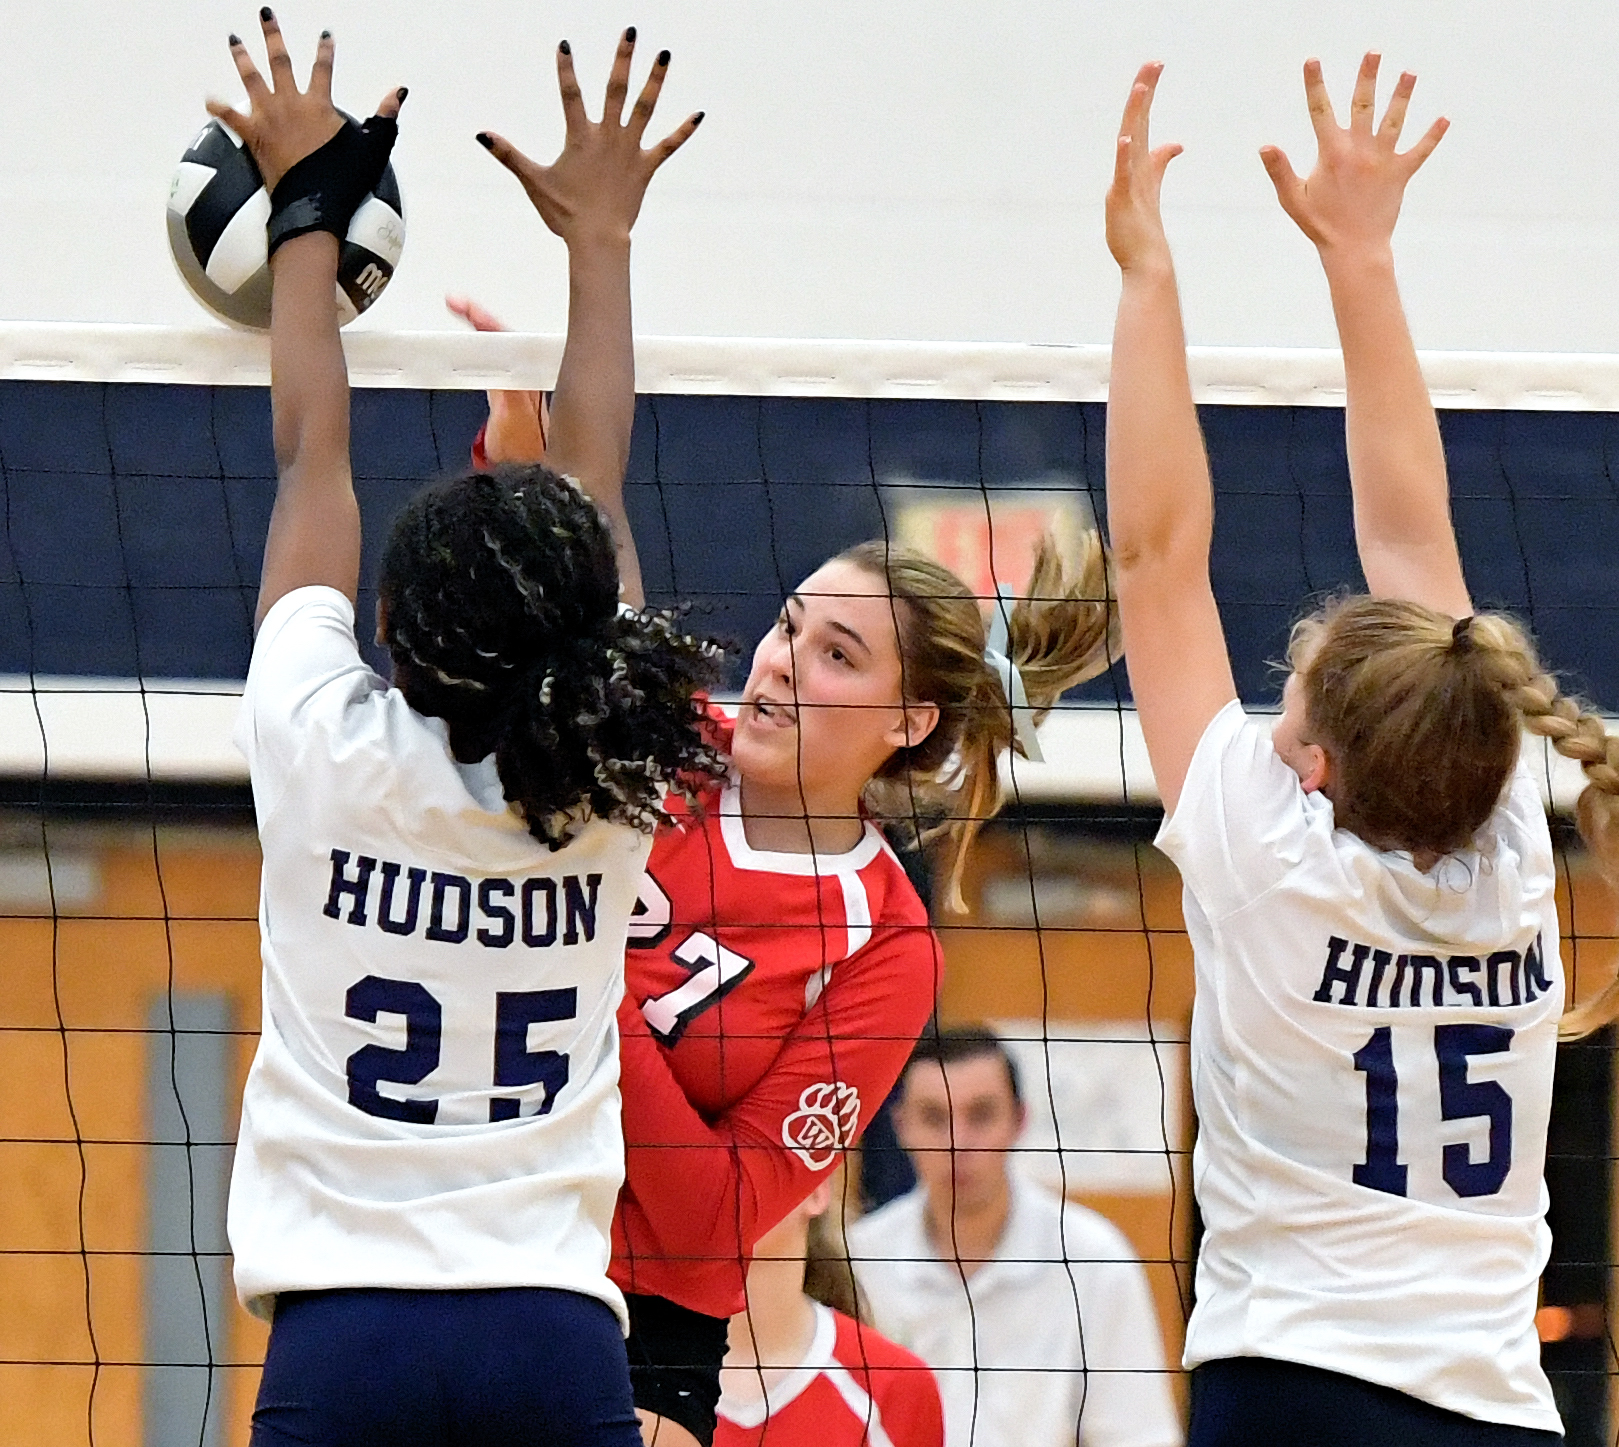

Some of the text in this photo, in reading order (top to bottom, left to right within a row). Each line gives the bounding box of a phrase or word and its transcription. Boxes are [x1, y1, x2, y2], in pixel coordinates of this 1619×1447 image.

[322, 848, 603, 948] HUDSON
[1312, 930, 1554, 1008] HUDSON
[344, 974, 578, 1124] 25
[1352, 1023, 1515, 1198] 15
